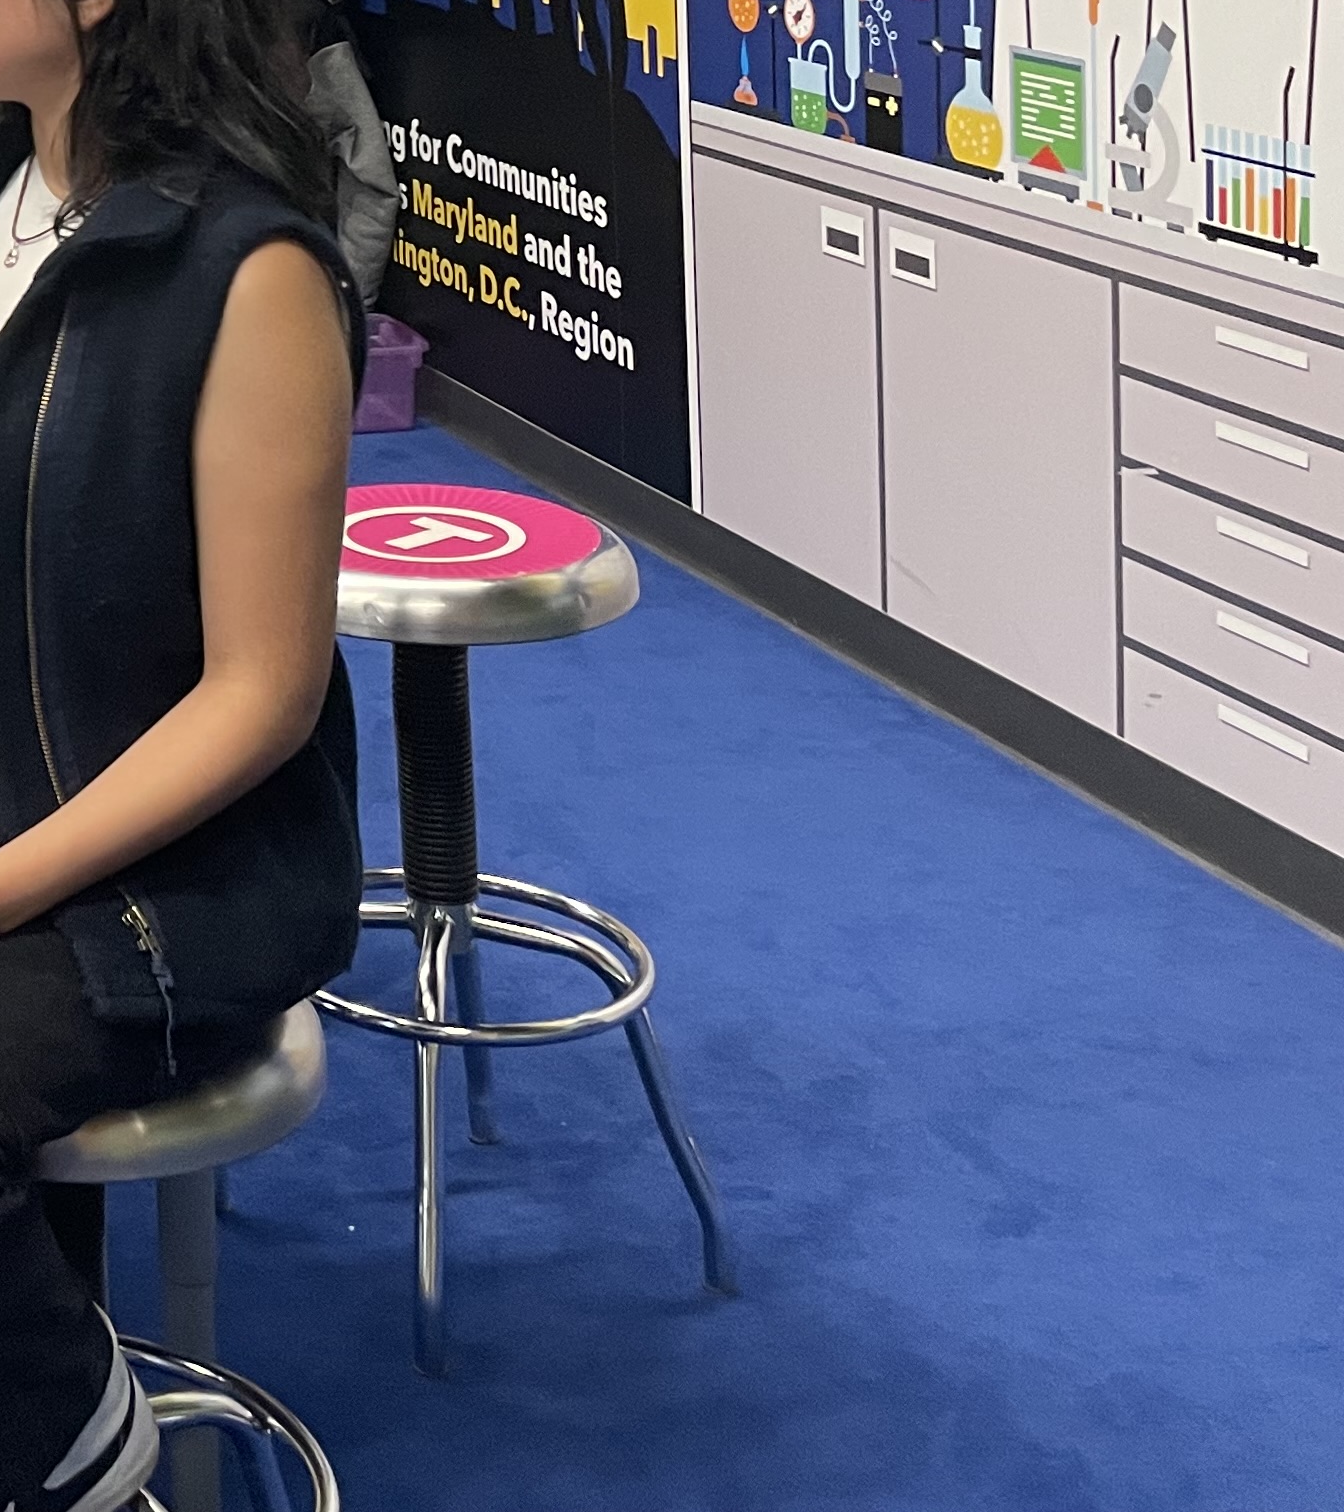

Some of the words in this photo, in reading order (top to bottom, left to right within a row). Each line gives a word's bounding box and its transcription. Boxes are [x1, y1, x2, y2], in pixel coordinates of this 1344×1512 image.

[410, 118, 441, 165] for
[446, 133, 608, 228] Communities
[412, 179, 518, 256] Maryland
[524, 230, 571, 278] and
[577, 244, 623, 299] the
[480, 265, 535, 330] D.C.,
[541, 290, 634, 372] Region
[385, 516, 494, 550] T
